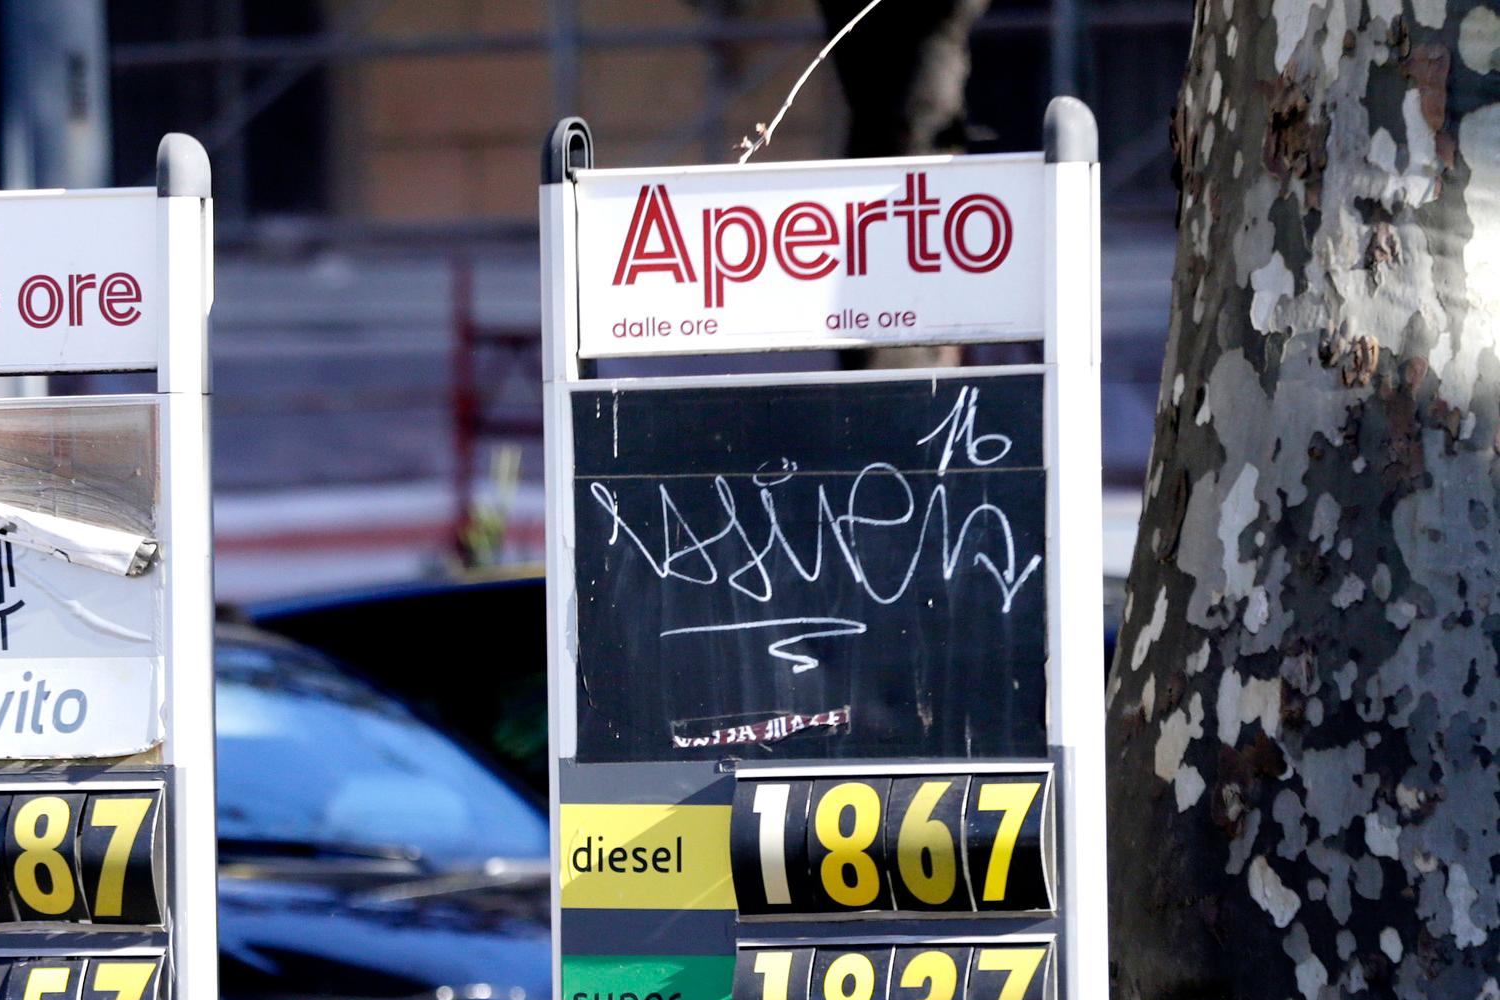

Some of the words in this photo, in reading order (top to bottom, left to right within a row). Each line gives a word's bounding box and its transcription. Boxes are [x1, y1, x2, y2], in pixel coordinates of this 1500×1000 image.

[612, 172, 1013, 309] Aperto
[18, 271, 142, 329] ore
[825, 308, 870, 331] alle
[877, 310, 917, 329] ore
[611, 317, 672, 339] dalle
[679, 317, 719, 337] ore
[571, 836, 683, 874] diesel
[751, 780, 1041, 907] 1867
